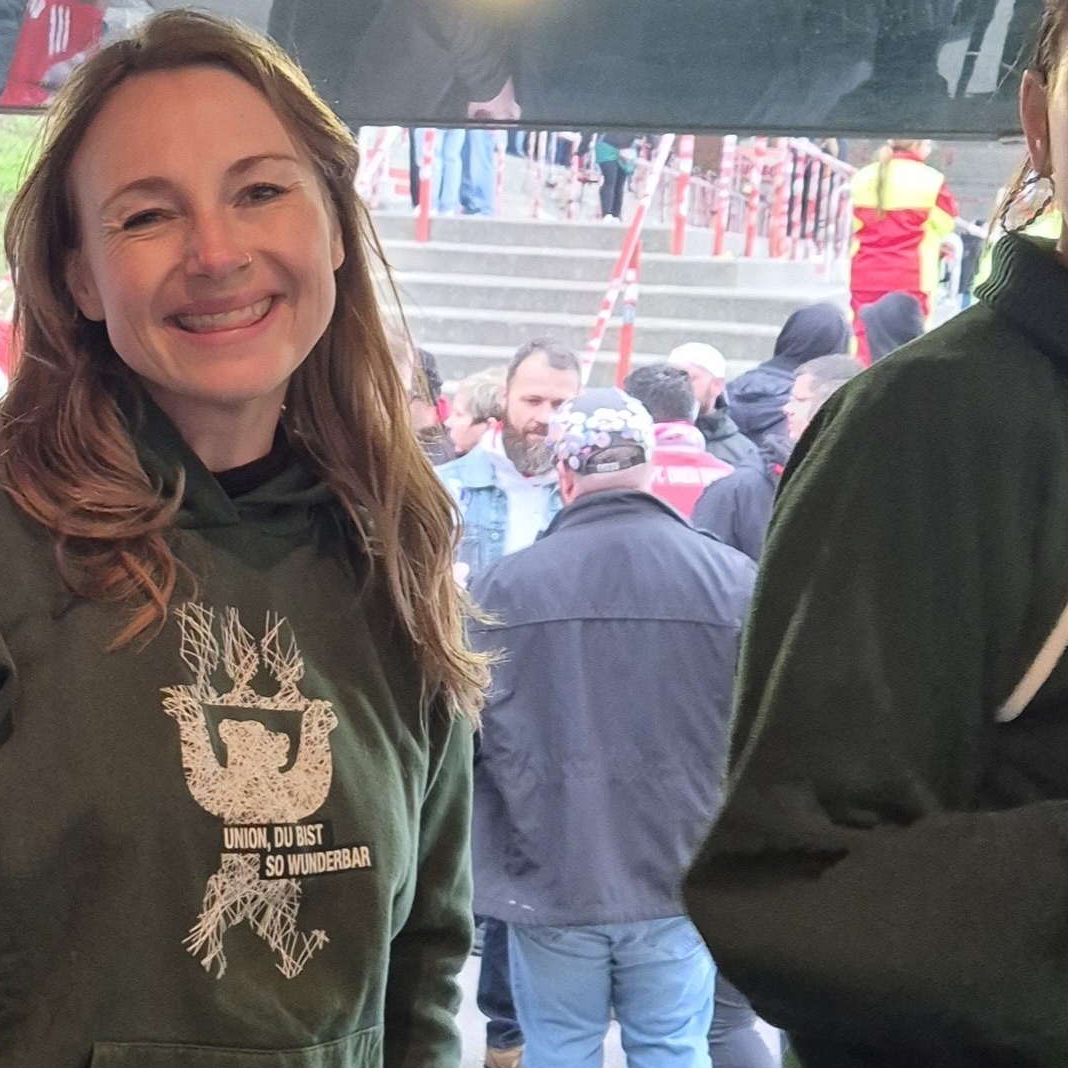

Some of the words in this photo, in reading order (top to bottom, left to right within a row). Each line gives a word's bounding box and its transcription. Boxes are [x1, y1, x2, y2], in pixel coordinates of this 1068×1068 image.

[224, 826, 271, 852] UNION,
[274, 826, 293, 849] DU
[296, 824, 323, 846] BIST
[265, 854, 285, 877] SO
[287, 846, 372, 875] WUNDERBAR
